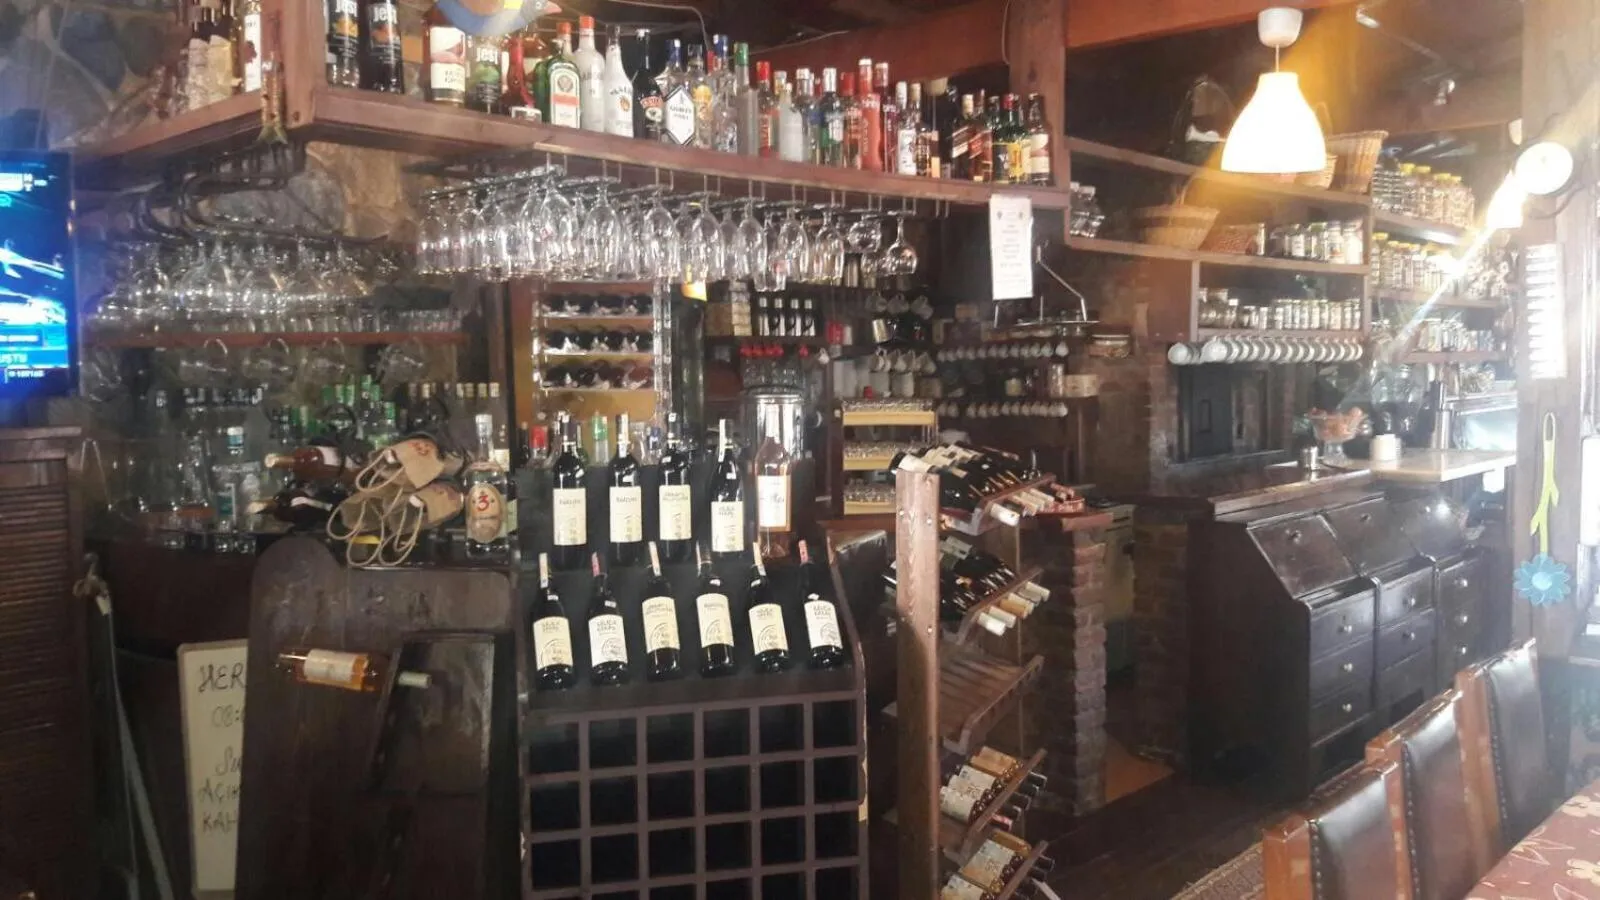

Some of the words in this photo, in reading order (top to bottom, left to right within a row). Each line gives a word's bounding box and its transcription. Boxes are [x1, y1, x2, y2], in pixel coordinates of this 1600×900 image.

[477, 495, 489, 511] 3
[198, 662, 246, 693] HER
[212, 704, 243, 727] 08:
